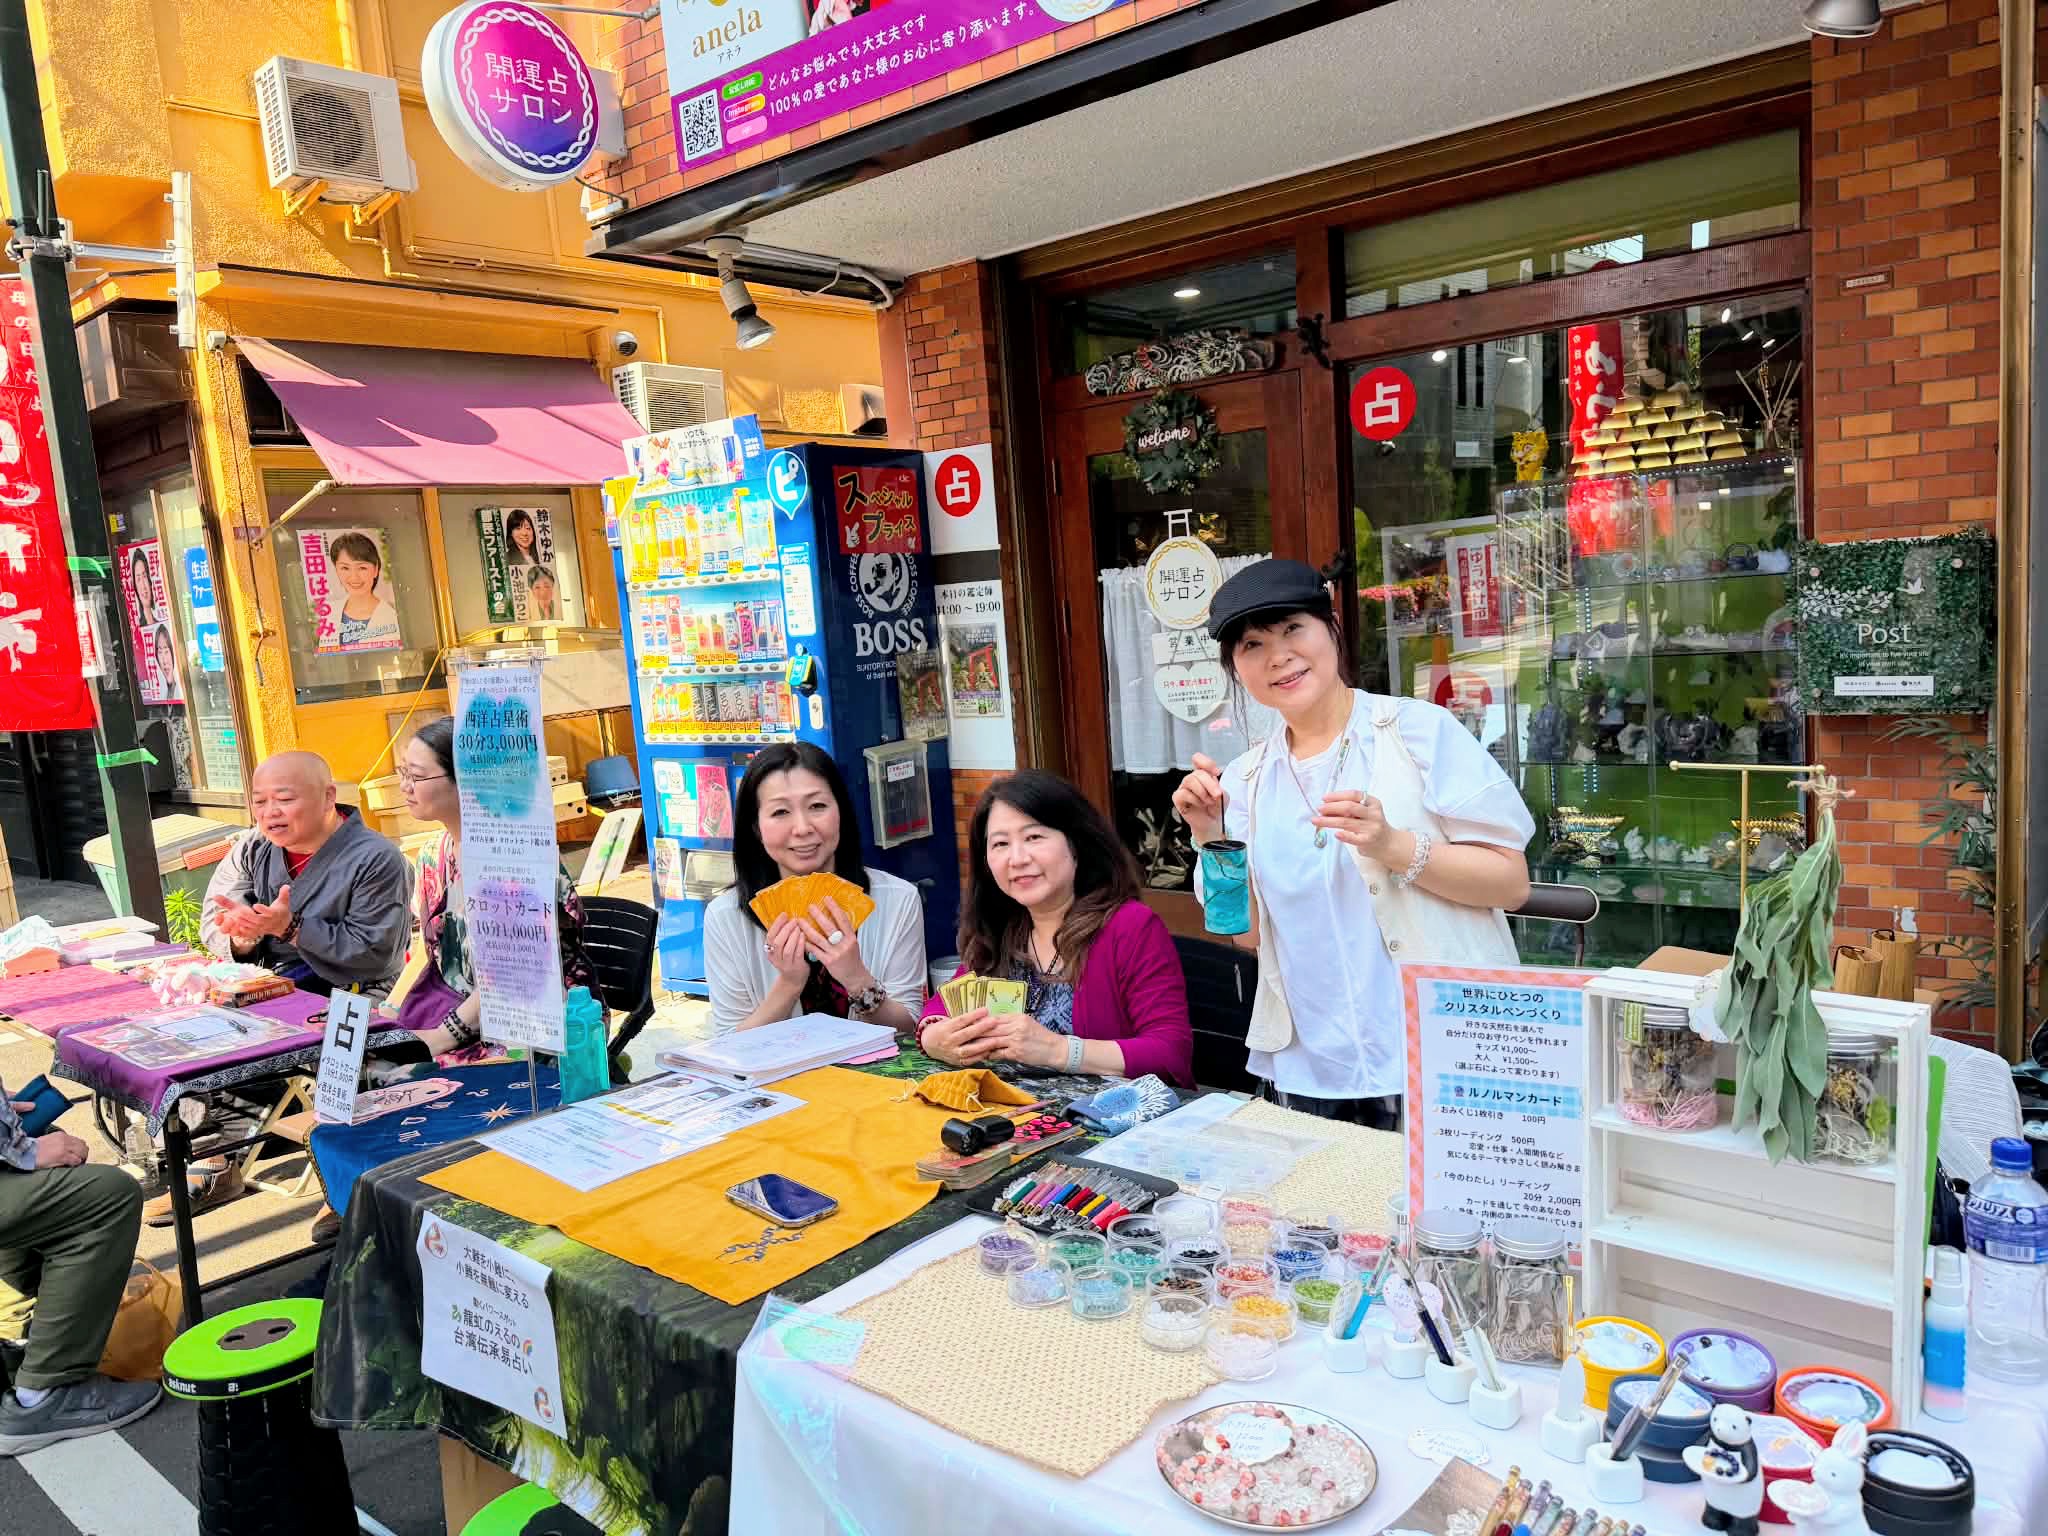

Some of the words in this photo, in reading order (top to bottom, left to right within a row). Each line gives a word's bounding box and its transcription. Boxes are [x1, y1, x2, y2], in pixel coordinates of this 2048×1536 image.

[692, 7, 763, 58] anela
[716, 45, 741, 64] アネラ
[768, 13, 926, 91] どんなお悩みでも大丈夫です
[485, 52, 568, 95] 開運占
[490, 87, 572, 124] サロン
[1364, 381, 1401, 428] 占
[1138, 426, 1191, 448] welcome
[838, 471, 913, 513] スペシャル
[945, 467, 971, 506] 占
[863, 511, 916, 543] プライス
[301, 534, 336, 637] 吉田はるみ
[1160, 567, 1205, 584] 開運占
[1160, 587, 1206, 601] サロン
[976, 601, 1001, 612] 19:00
[853, 617, 928, 657] BOSS
[1858, 623, 1912, 644] Post
[467, 897, 552, 918] タロットカード
[1462, 987, 1544, 1003] 世界にひとつの
[1444, 1001, 1562, 1020] クリスタルペンづくり
[334, 1001, 359, 1052] 占
[1465, 1020, 1544, 1034] 好きな天然石を選んで
[1475, 1043, 1499, 1052] キッズ
[1475, 1053, 1491, 1062] 大人
[1468, 1087, 1562, 1107] ルノルマンカード
[1440, 1106, 1504, 1120] おみくじ1枚引き
[1521, 1114, 1546, 1125] 100円
[1439, 1128, 1502, 1142] 3枚リーディング
[1511, 1136, 1535, 1146] 500円
[1469, 1142, 1564, 1159] 恋愛・仕事・人間関係など
[1523, 1192, 1542, 1202] 20分
[1548, 1196, 1581, 1207] 2,000円
[453, 1326, 534, 1376] 台湾伝承易占い
